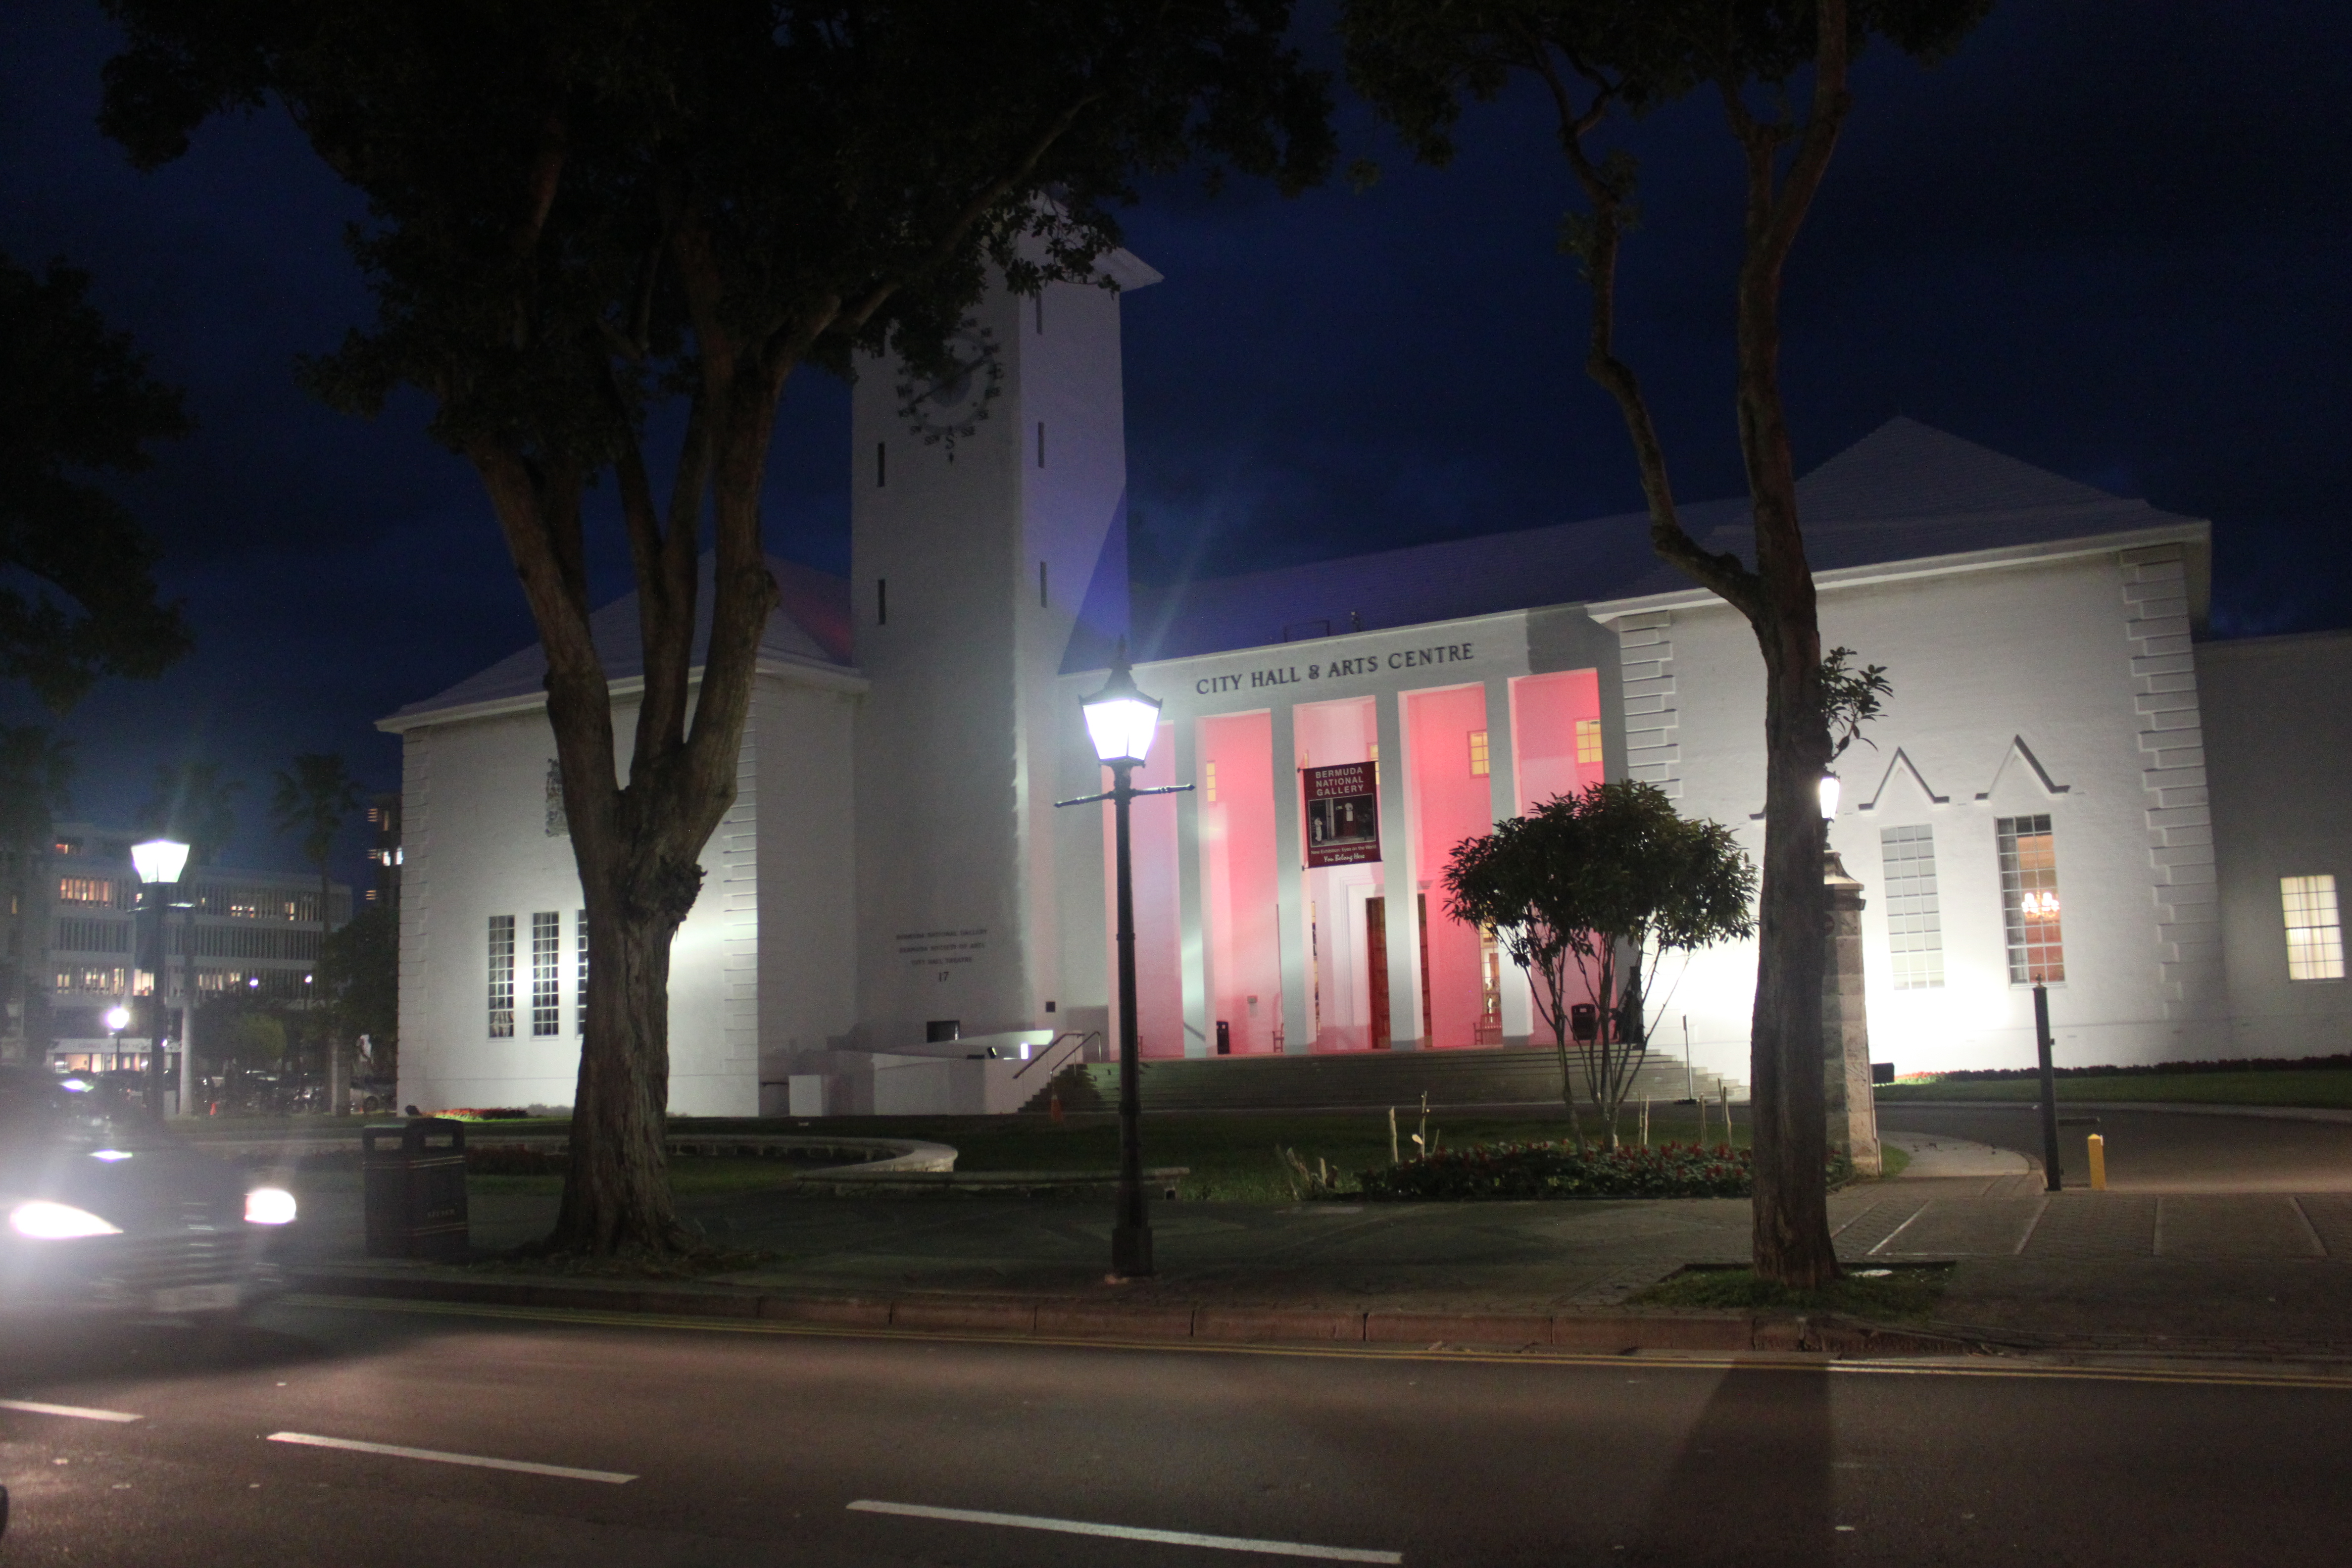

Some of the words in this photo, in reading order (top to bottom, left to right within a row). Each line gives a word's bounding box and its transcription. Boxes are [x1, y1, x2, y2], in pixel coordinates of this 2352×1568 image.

[945, 433, 954, 449] S
[1196, 674, 1243, 695] CITY
[1251, 667, 1301, 688] HALL
[1328, 656, 1379, 678] ARTS
[1388, 643, 1474, 670] CENTRE
[1315, 767, 1363, 779] BERMUDA
[1316, 776, 1364, 788] NATIONAL
[1317, 784, 1364, 796] GALLERY
[939, 971, 949, 982] 17
